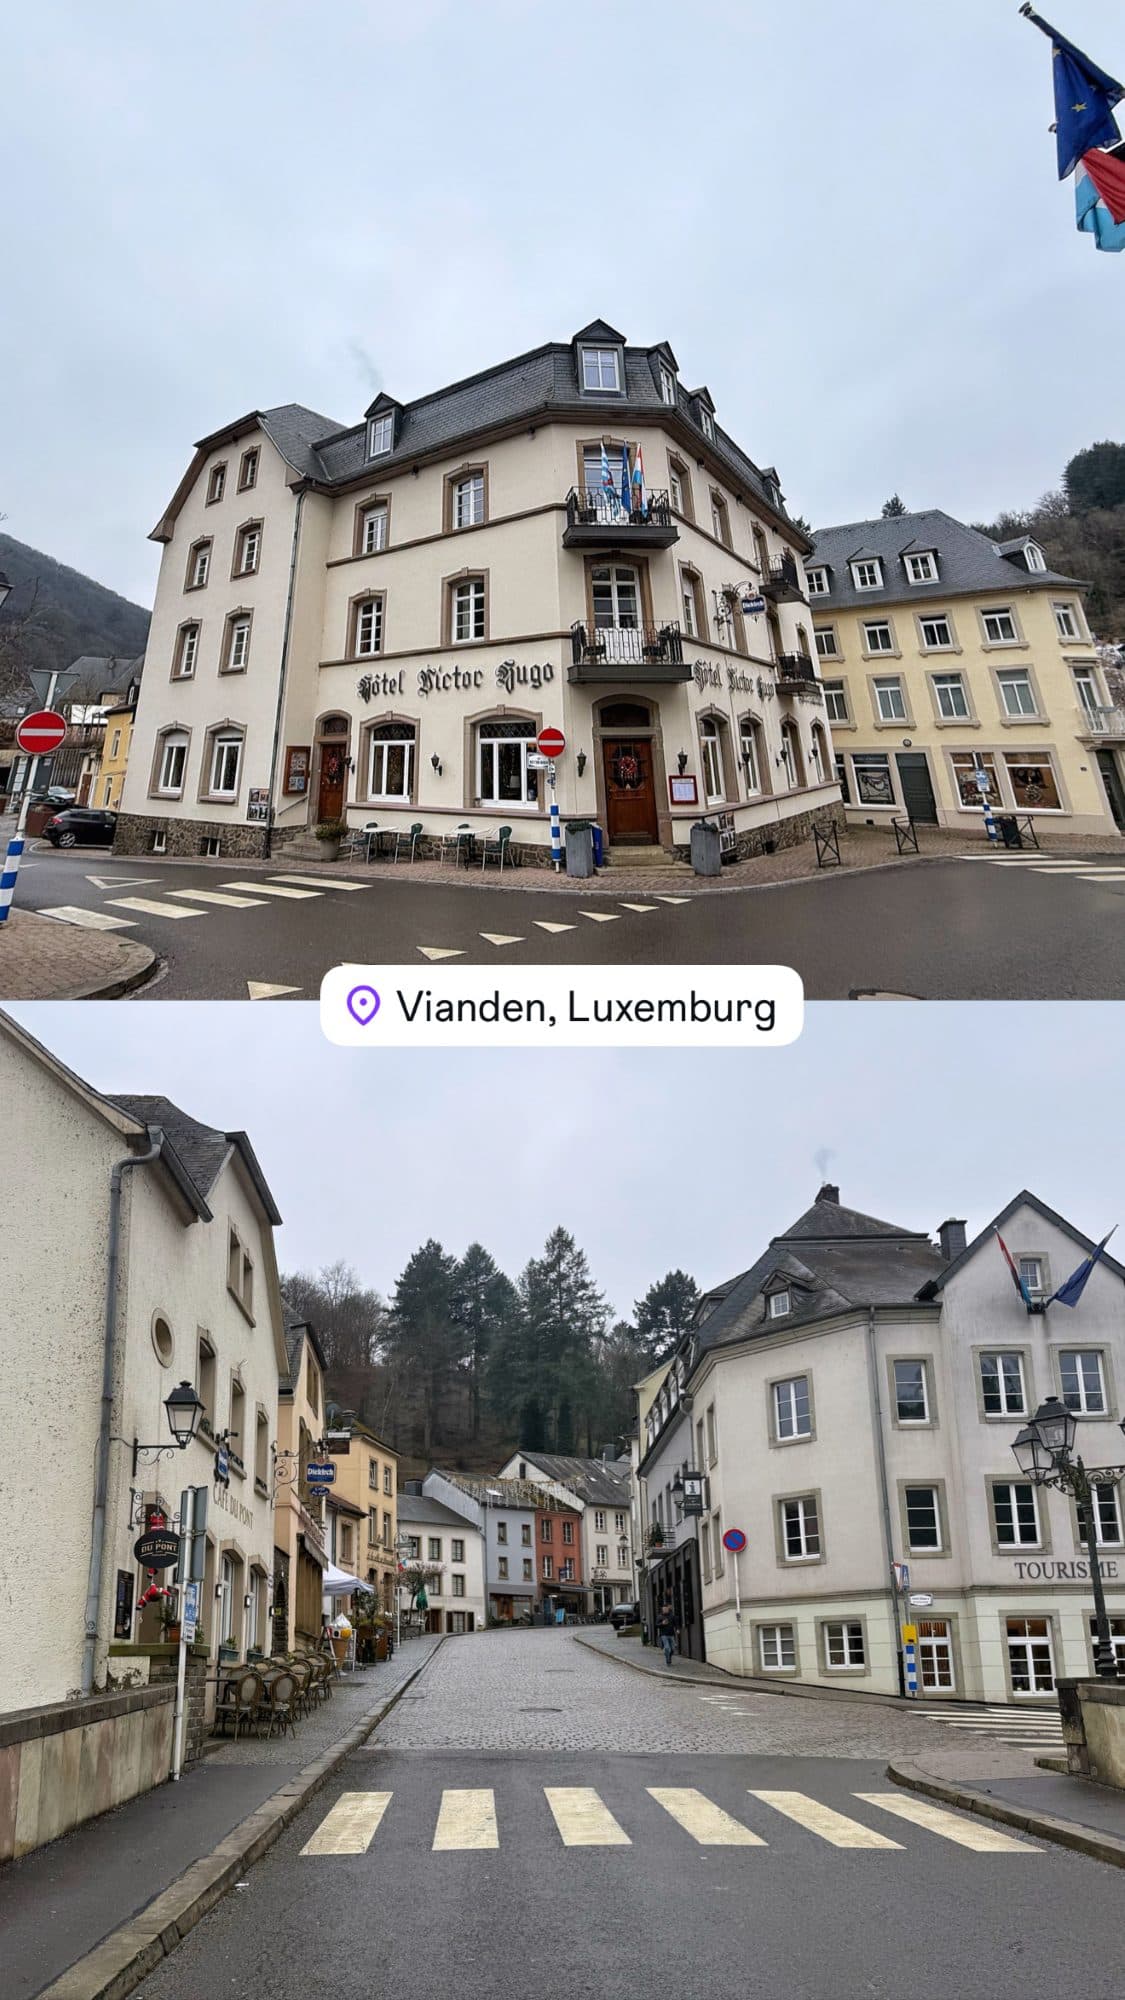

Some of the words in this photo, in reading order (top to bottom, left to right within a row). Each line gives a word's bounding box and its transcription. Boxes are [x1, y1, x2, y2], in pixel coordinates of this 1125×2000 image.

[357, 668, 405, 704] Hôtel
[417, 663, 484, 700] Victor
[496, 658, 555, 694] Hugo
[141, 1544, 153, 1553] DU
[155, 1542, 177, 1551] PONT
